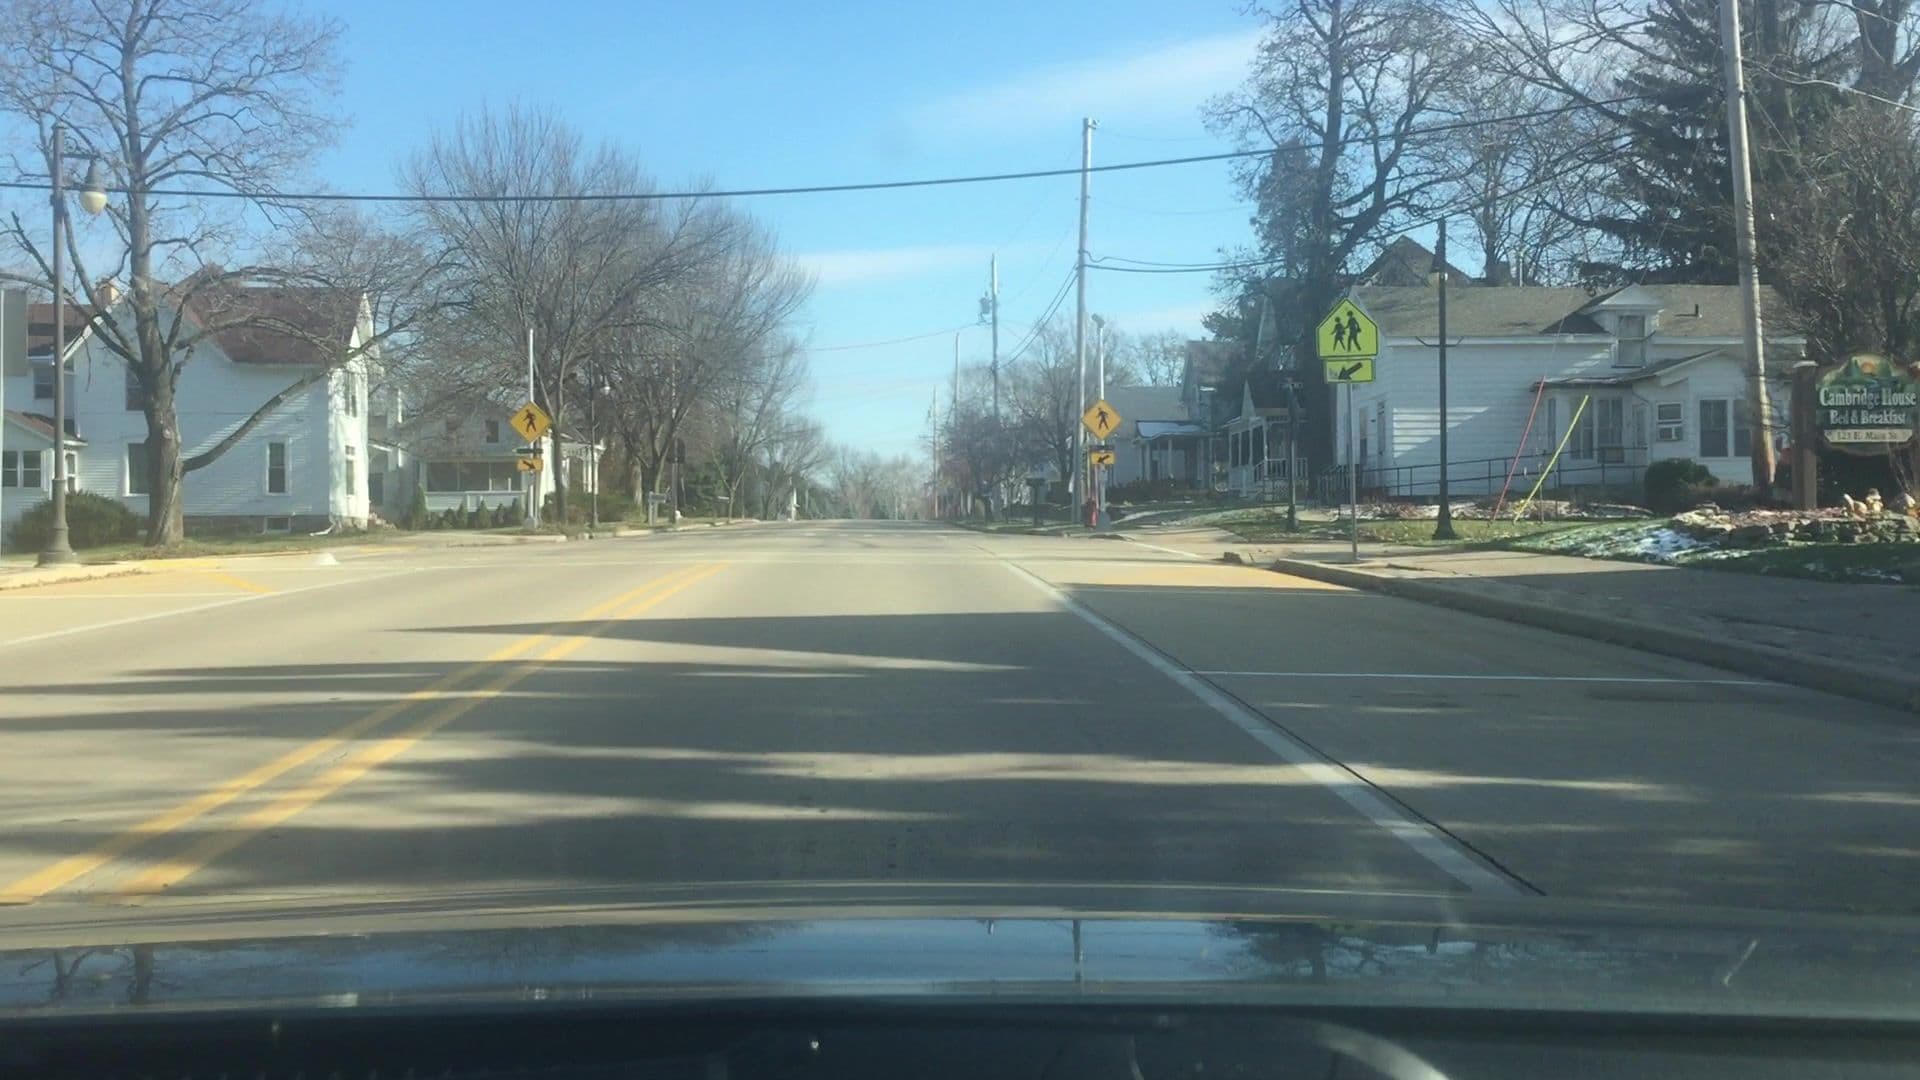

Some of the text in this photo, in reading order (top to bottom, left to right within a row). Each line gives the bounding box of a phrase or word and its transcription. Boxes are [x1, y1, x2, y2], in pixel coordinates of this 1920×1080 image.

[1820, 387, 1917, 409] Cambridge House
[1830, 409, 1906, 424] Bed & Breakfast
